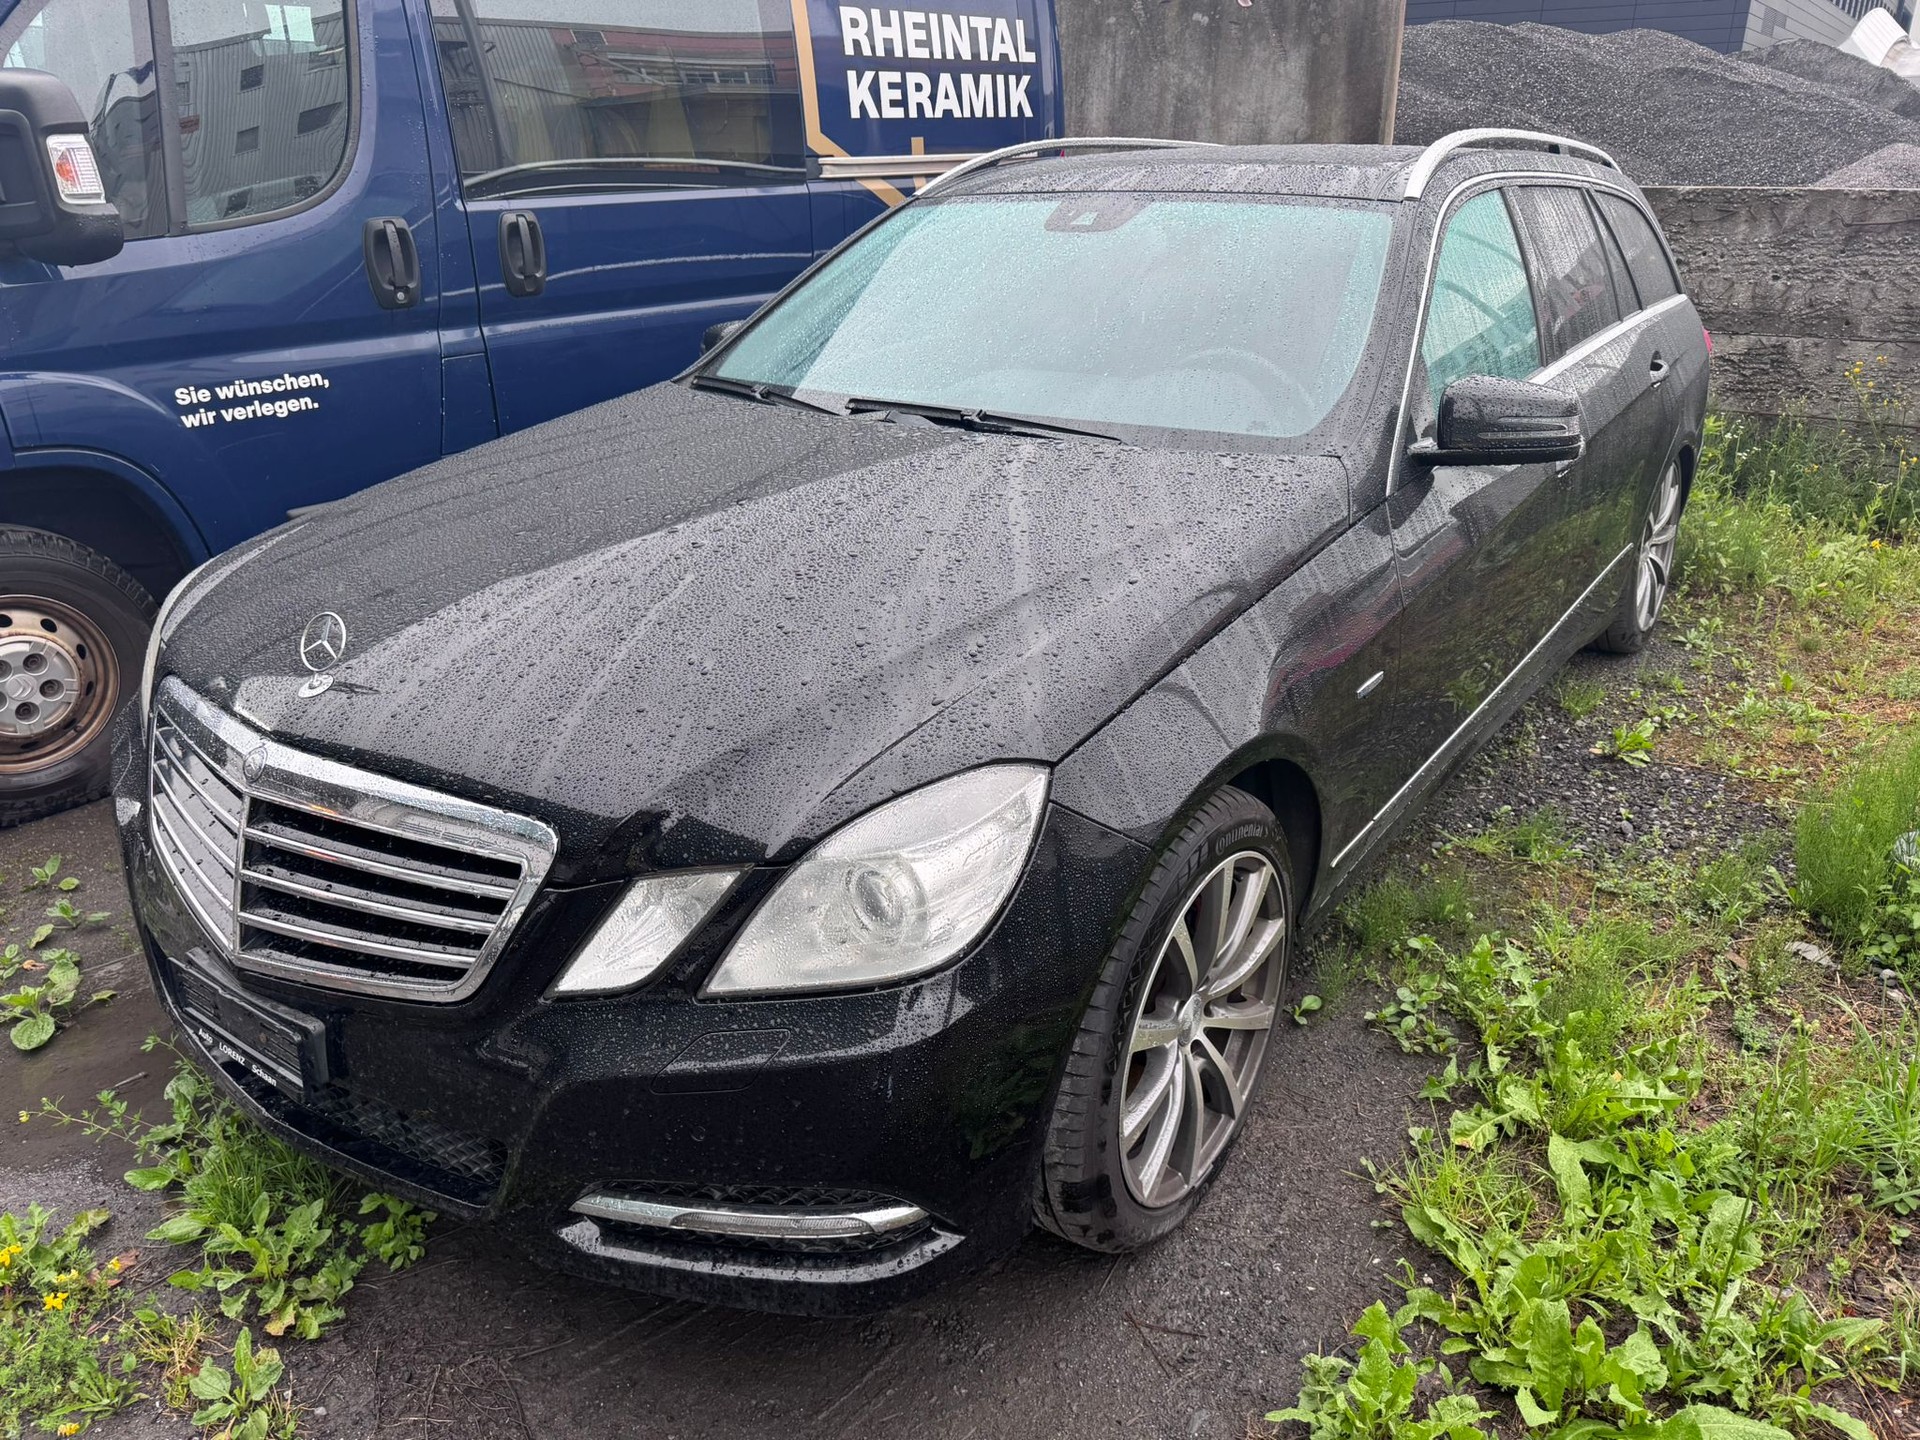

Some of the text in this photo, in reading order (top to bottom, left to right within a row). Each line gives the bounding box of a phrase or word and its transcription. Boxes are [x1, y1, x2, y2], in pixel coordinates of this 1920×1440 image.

[839, 6, 1036, 63] RHEINTAL
[847, 70, 1034, 119] KERAMIK
[174, 373, 330, 406] Sie wünschen,
[180, 396, 320, 429] wir verlegen.
[198, 1028, 277, 1087] Auto LORENZ Schaan
